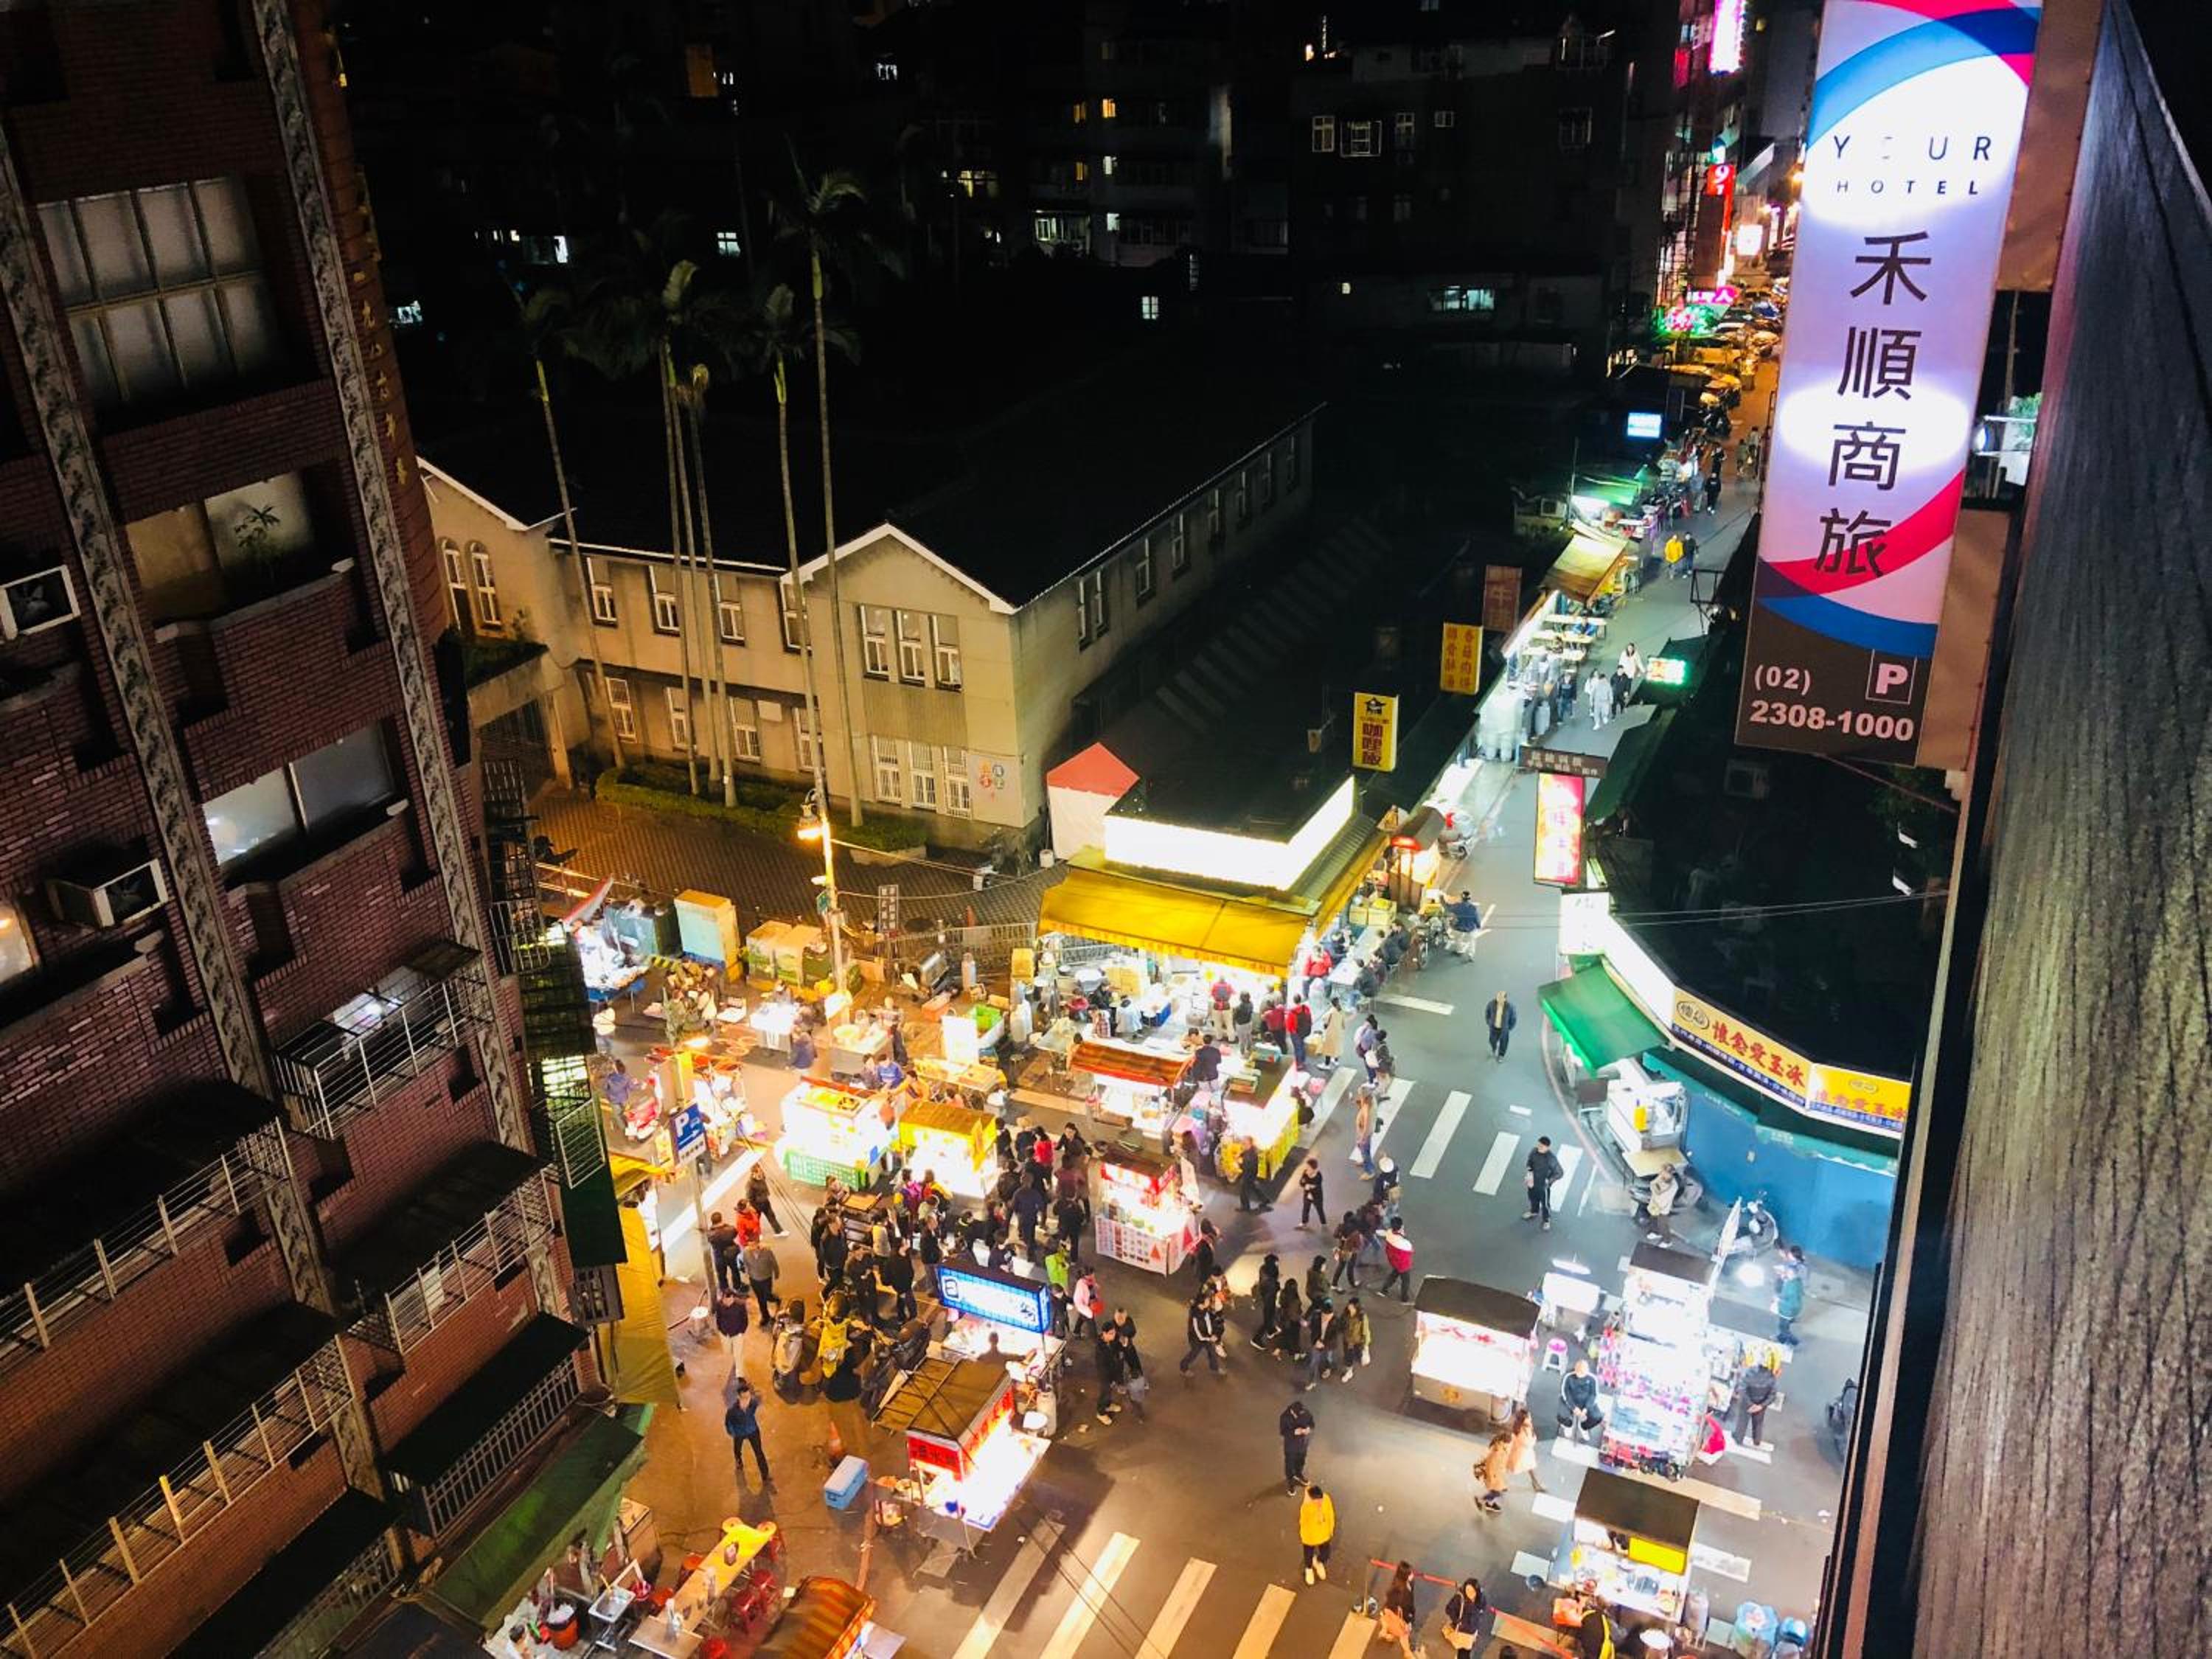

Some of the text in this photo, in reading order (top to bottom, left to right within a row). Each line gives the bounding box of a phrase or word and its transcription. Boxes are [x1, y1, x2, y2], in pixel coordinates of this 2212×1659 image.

[1834, 135, 1992, 161] YUR
[1837, 180, 1978, 195] HOTEL
[1812, 231, 1932, 578] 禾順商旅
[1755, 664, 1811, 696] (02)
[1875, 663, 1908, 695] P
[1750, 700, 1914, 741] 2308-1000
[675, 1112, 690, 1137] P
